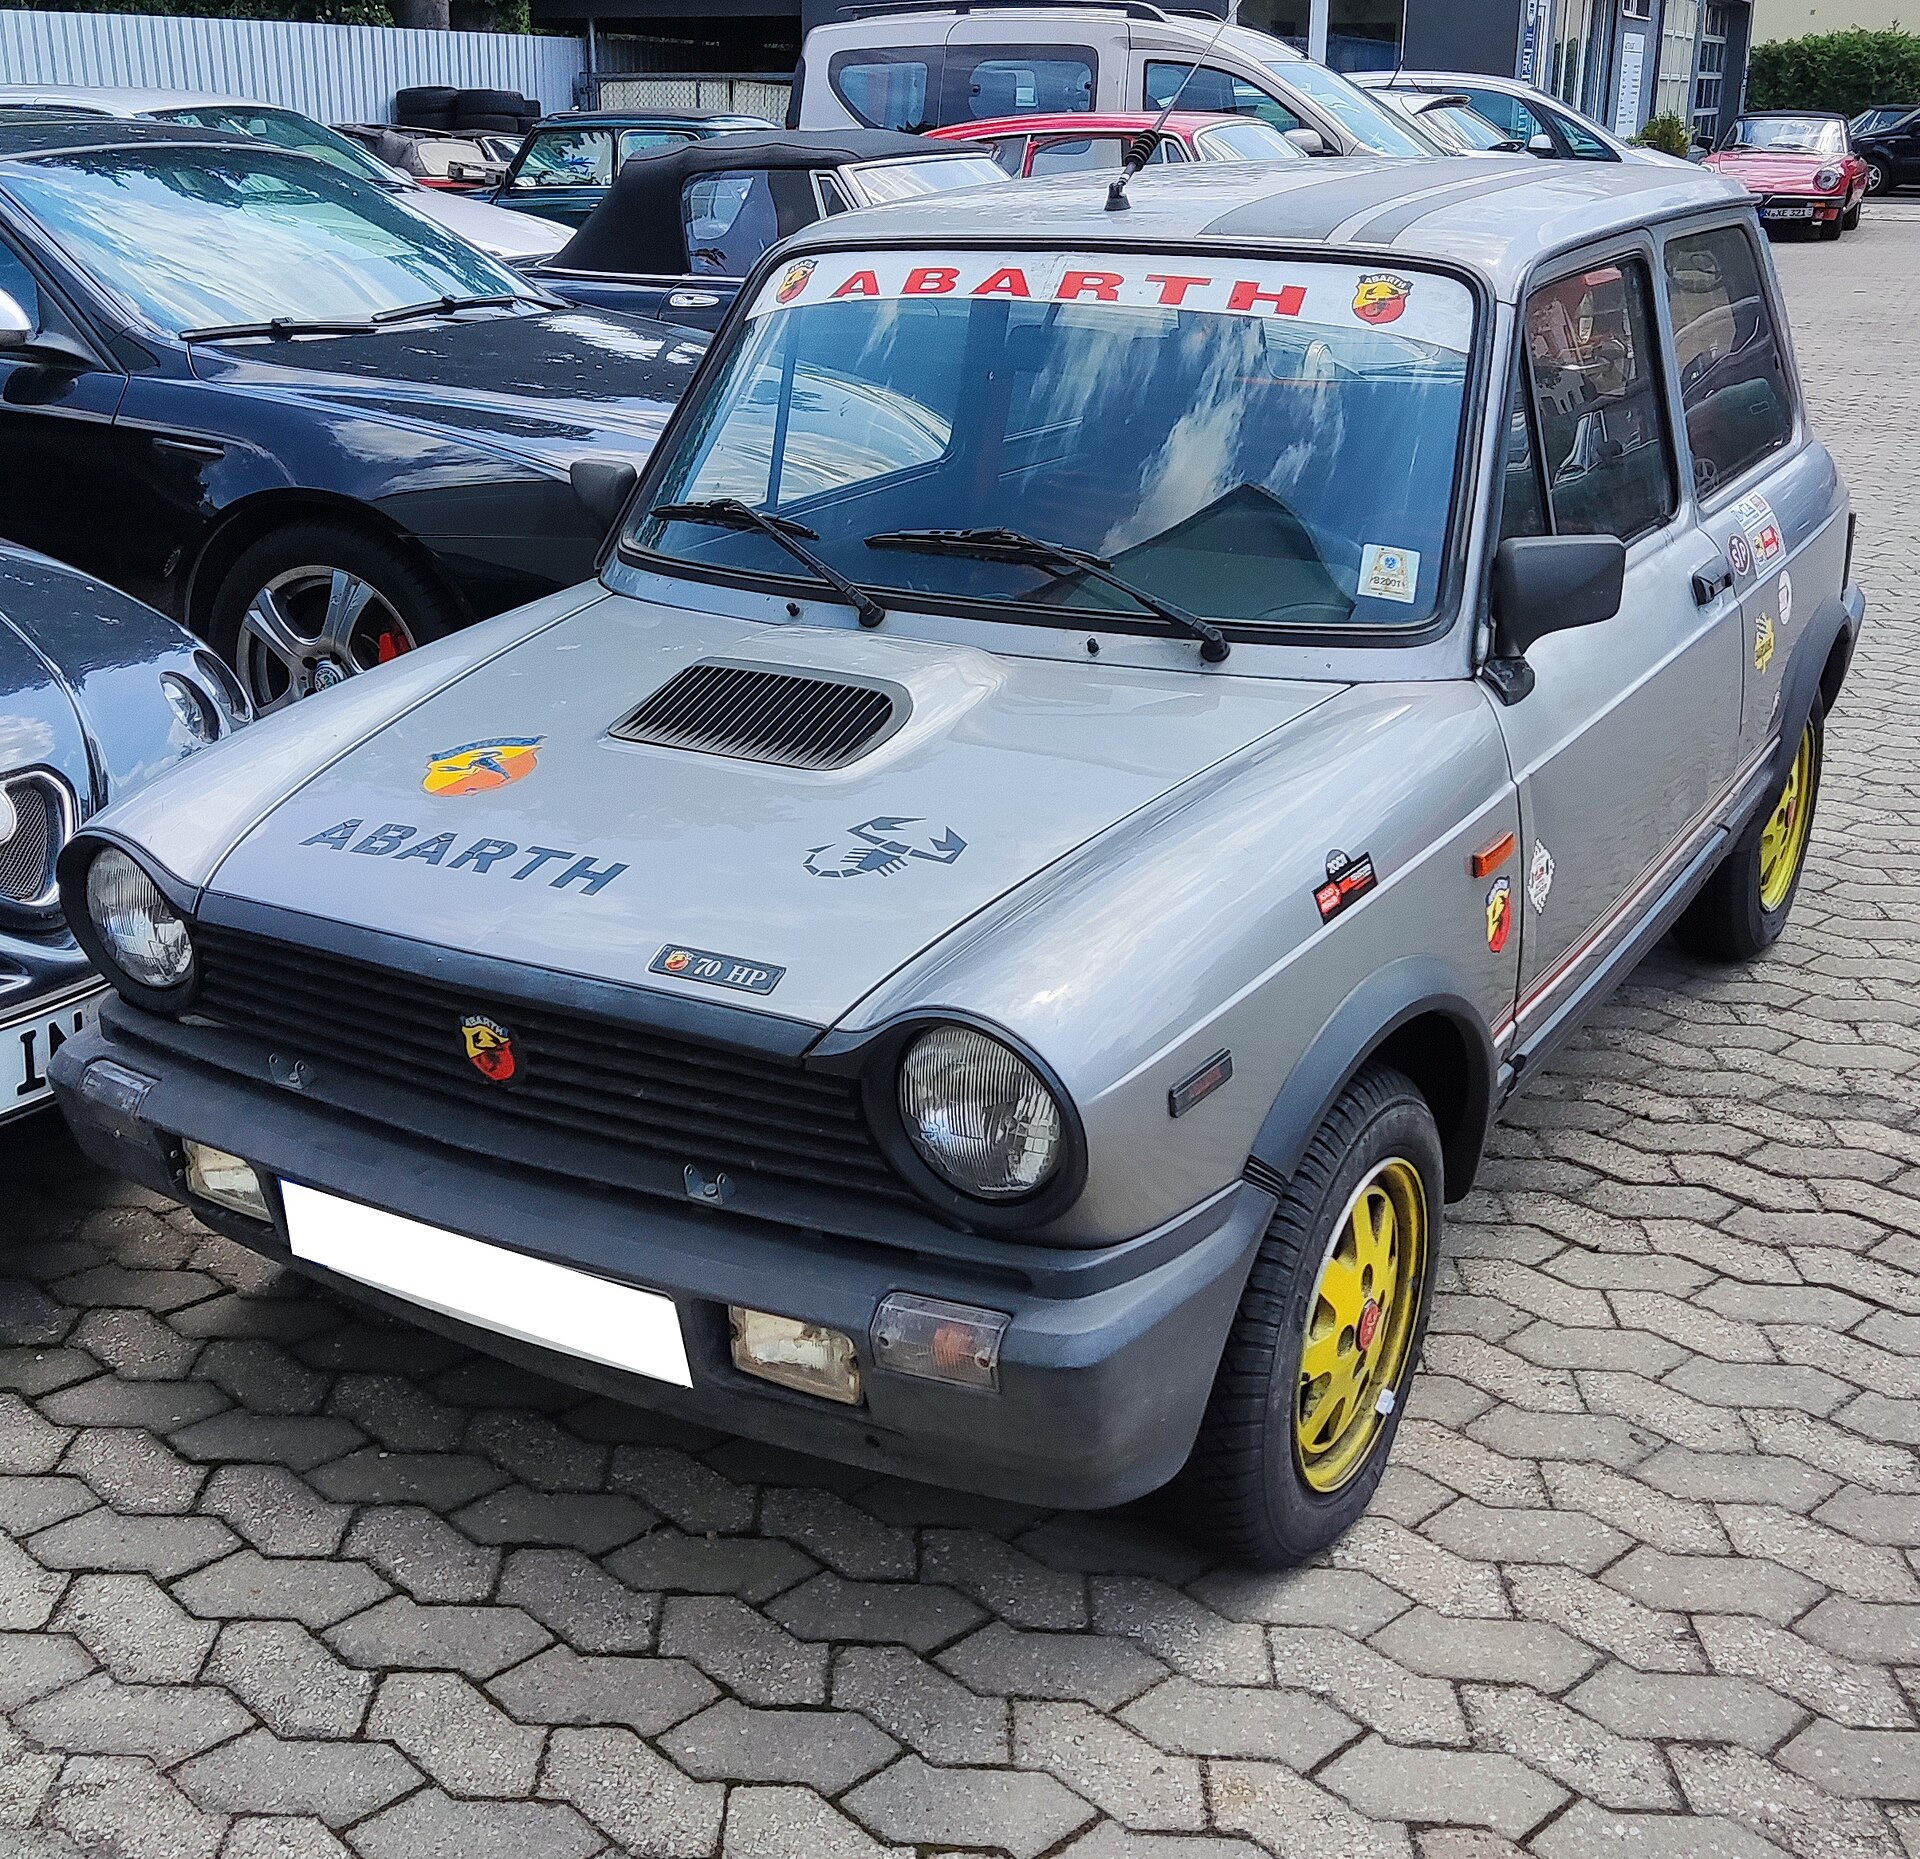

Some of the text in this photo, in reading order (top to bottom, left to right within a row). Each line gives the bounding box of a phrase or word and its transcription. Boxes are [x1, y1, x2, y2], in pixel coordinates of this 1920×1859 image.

[1776, 209, 1789, 217] XE
[827, 267, 1308, 316] ABARTH
[1363, 274, 1408, 289] ABARTH
[299, 817, 631, 897] ABARTH
[693, 957, 768, 987] 70 HP
[465, 1015, 504, 1035] ABARTH
